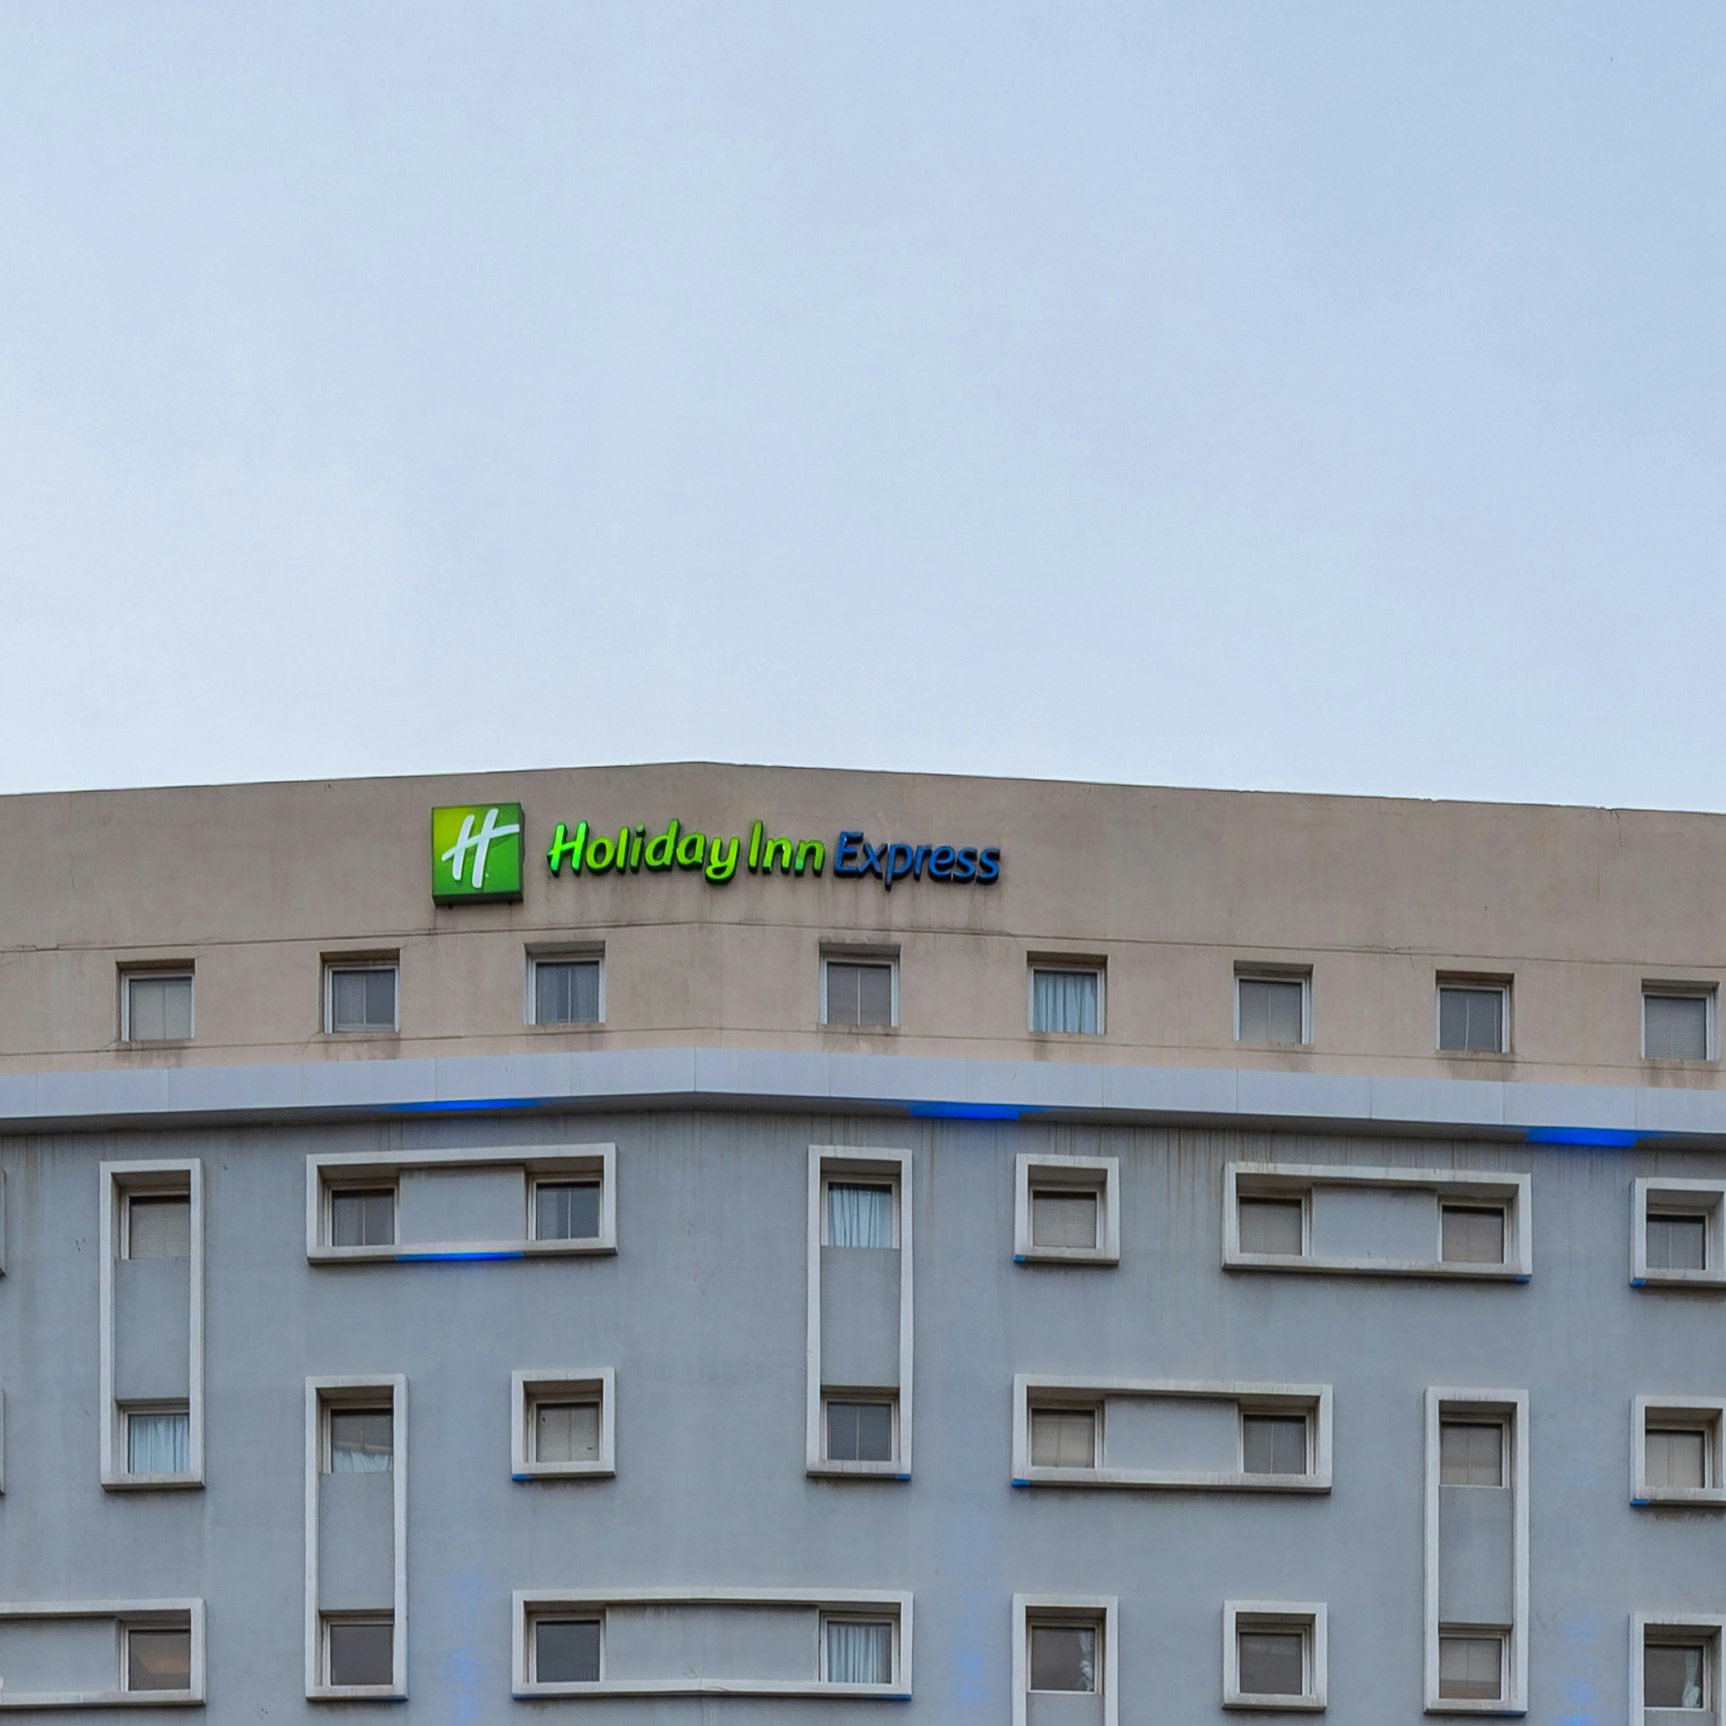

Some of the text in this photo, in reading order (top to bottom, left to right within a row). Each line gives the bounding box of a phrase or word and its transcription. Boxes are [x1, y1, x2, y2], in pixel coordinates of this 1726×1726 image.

[546, 818, 1000, 890] Holiday Inn Express
